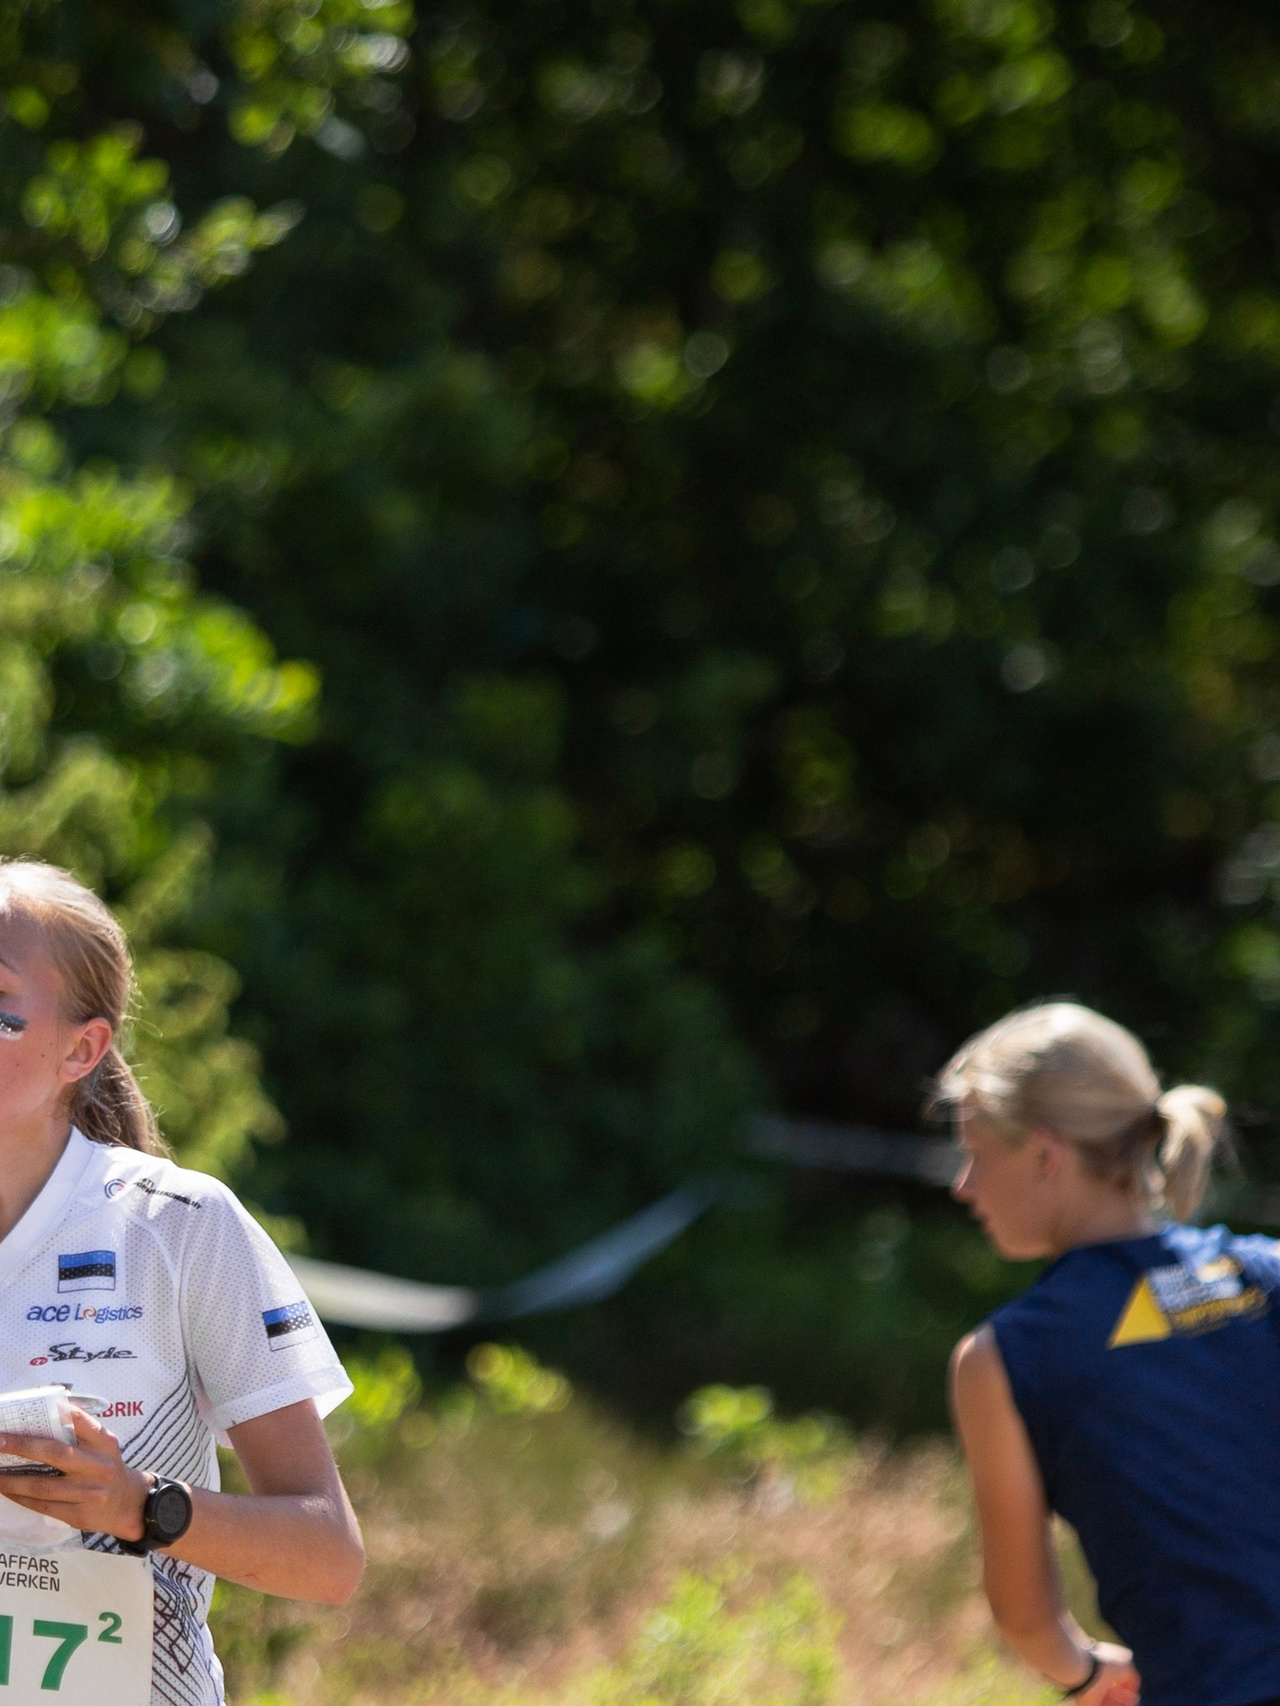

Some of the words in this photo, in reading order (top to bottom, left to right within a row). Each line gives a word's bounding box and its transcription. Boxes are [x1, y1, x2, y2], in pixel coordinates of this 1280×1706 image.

[26, 1304, 71, 1322] ace
[75, 1303, 143, 1324] Logistics
[96, 1400, 144, 1418] BRIK
[98, 1611, 123, 1644] 2
